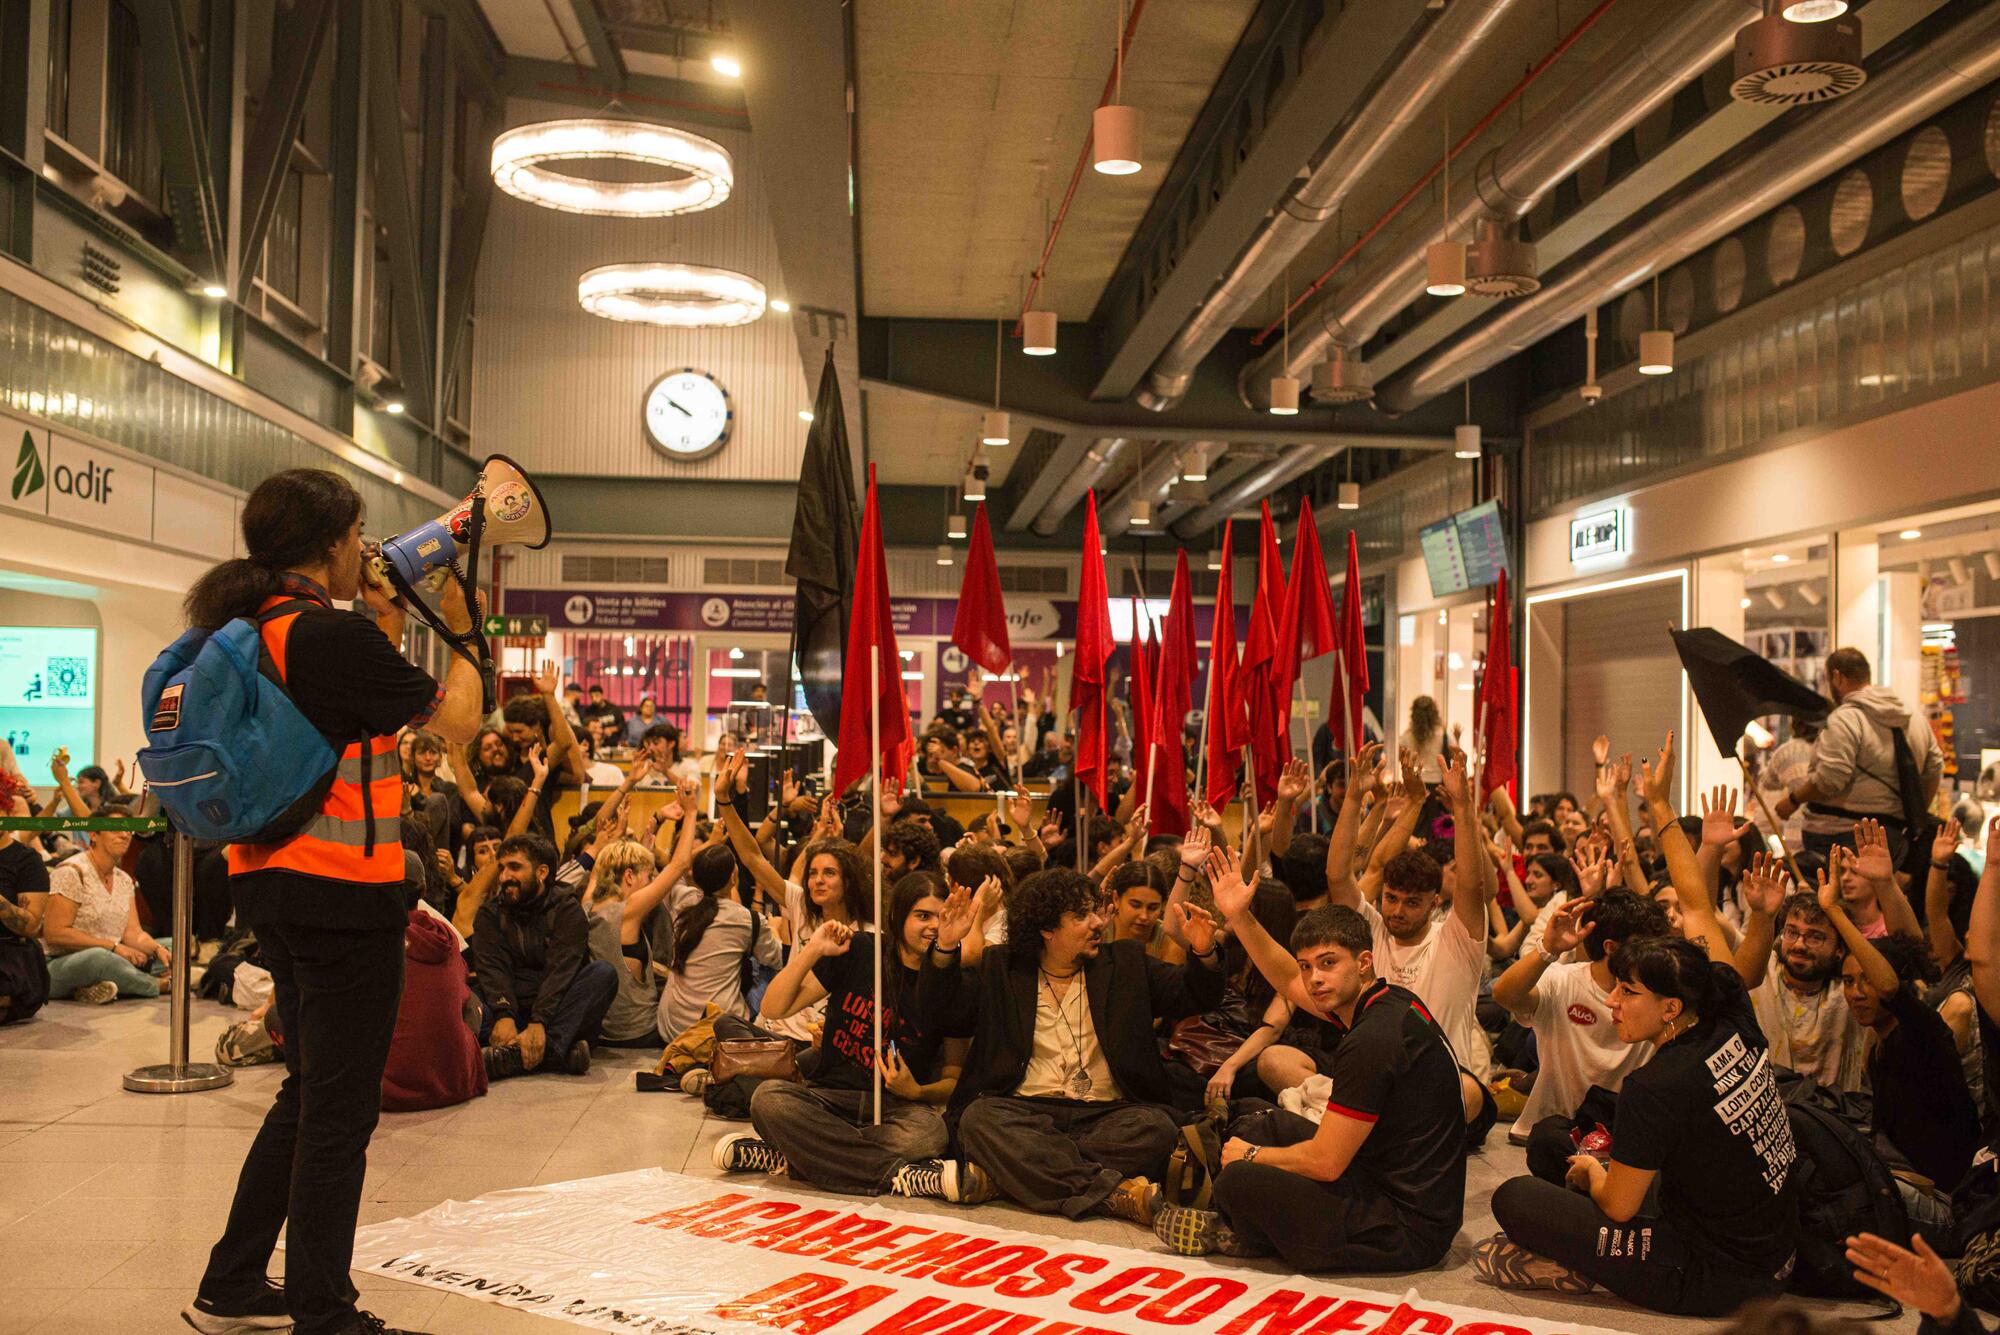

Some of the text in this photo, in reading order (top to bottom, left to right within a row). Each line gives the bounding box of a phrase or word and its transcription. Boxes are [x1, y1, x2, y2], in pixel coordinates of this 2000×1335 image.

[54, 460, 114, 504] adif
[595, 597, 666, 608] Venta de billetes
[1006, 608, 1043, 628] nfe
[849, 1019, 869, 1039] DE
[1712, 1040, 1743, 1073] AMA O
[1721, 1089, 1751, 1118] LOITA
[632, 1193, 1109, 1298] ACABEMOS
[1069, 1266, 1248, 1325] CO
[705, 1272, 899, 1335] DA
